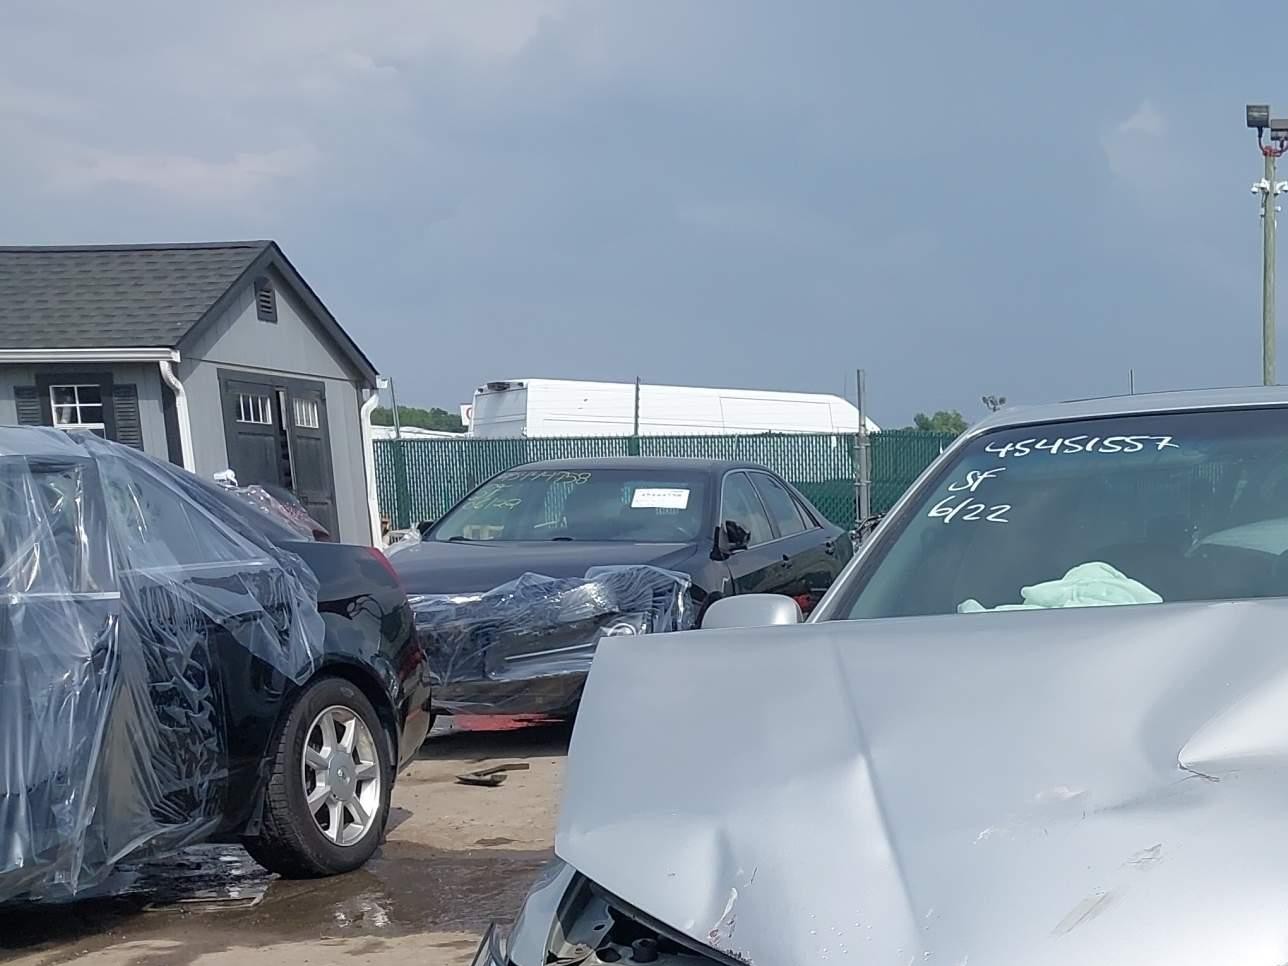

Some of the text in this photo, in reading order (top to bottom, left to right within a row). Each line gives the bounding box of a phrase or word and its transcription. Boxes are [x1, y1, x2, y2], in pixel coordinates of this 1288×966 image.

[985, 435, 1180, 457] 45451557
[948, 468, 1007, 492] SF
[928, 496, 1011, 523] 6/22
